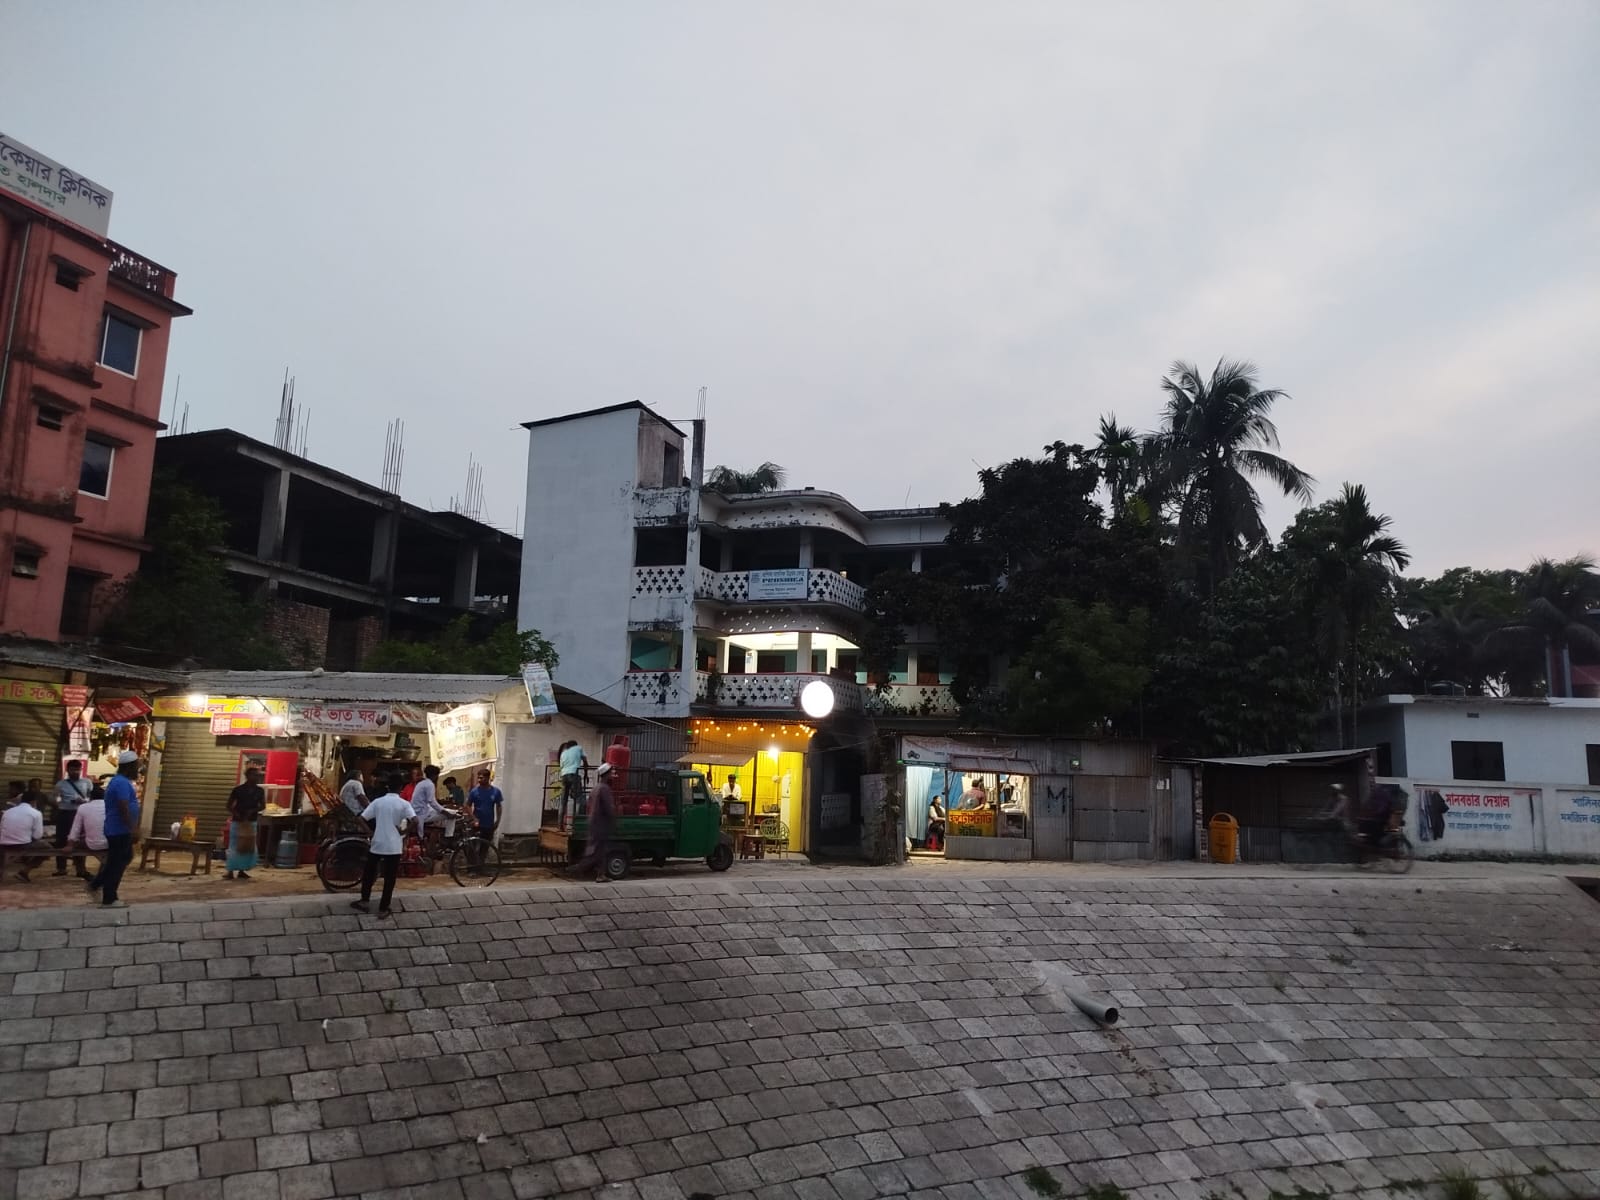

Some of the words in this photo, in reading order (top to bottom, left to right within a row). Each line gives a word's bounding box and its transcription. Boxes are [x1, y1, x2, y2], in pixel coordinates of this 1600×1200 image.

[58, 168, 108, 208] ক্লিনিক
[327, 709, 354, 722] ভাত
[357, 710, 377, 724] ঘর
[1445, 793, 1480, 807] মানবতার
[1483, 793, 1510, 808] দেয়াল
